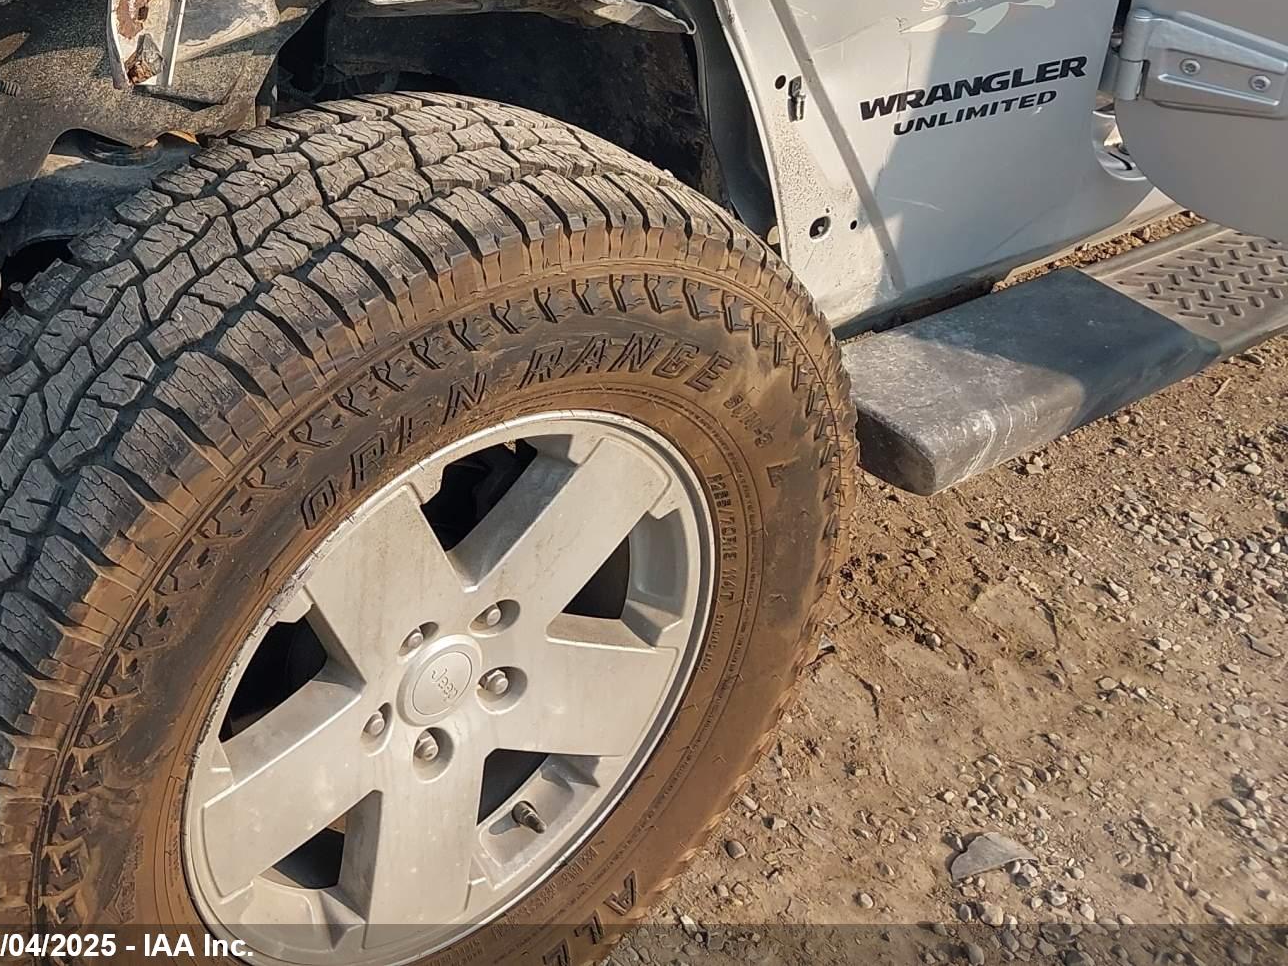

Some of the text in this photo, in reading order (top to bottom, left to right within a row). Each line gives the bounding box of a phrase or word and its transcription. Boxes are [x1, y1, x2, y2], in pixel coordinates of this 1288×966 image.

[859, 56, 1088, 121] WRANGLER
[893, 90, 1058, 136] UNLIMITED
[516, 333, 733, 393] RANGE
